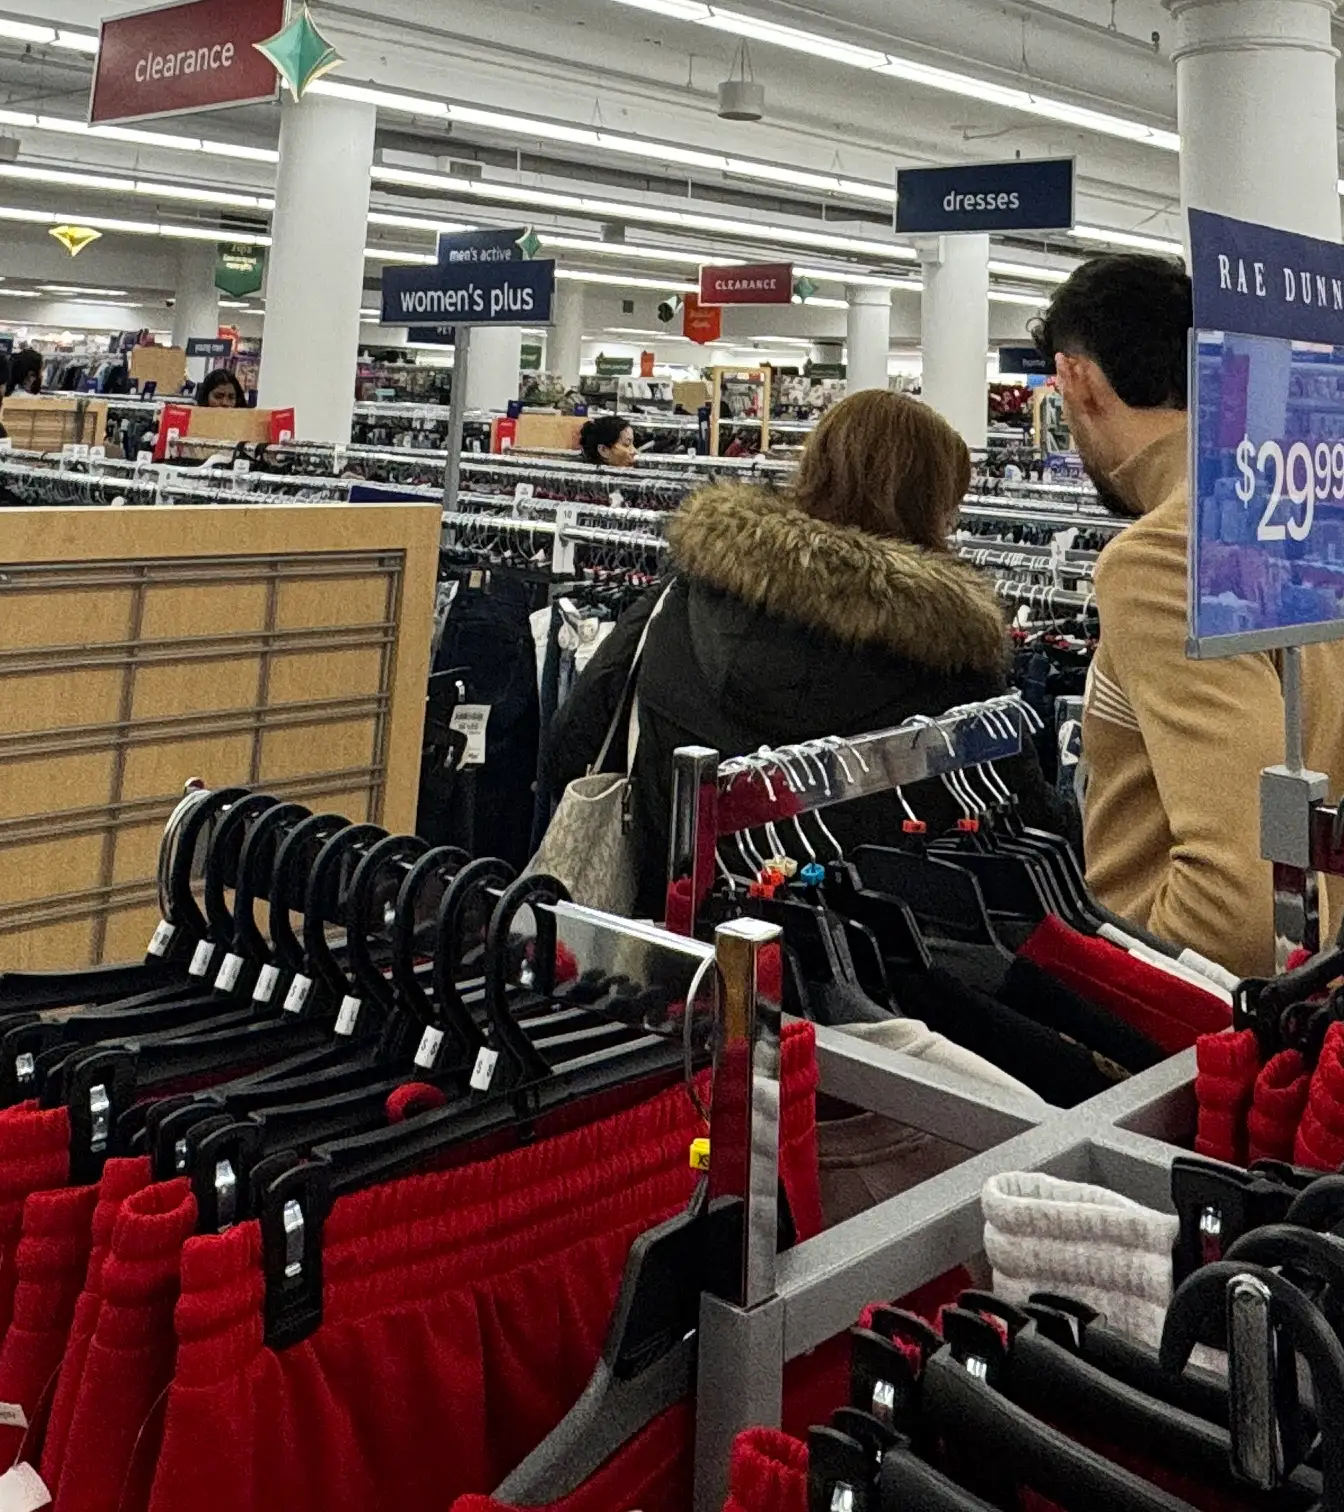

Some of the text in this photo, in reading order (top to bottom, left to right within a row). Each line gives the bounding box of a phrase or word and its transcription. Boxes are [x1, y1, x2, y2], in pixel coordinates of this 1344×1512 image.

[134, 40, 236, 84] clearance
[942, 188, 1020, 212] dresses
[449, 247, 512, 262] men's active
[714, 278, 777, 290] CLEARANCE
[1217, 253, 1266, 297] RAE
[400, 281, 534, 316] women's plus
[563, 509, 573, 519] 10
